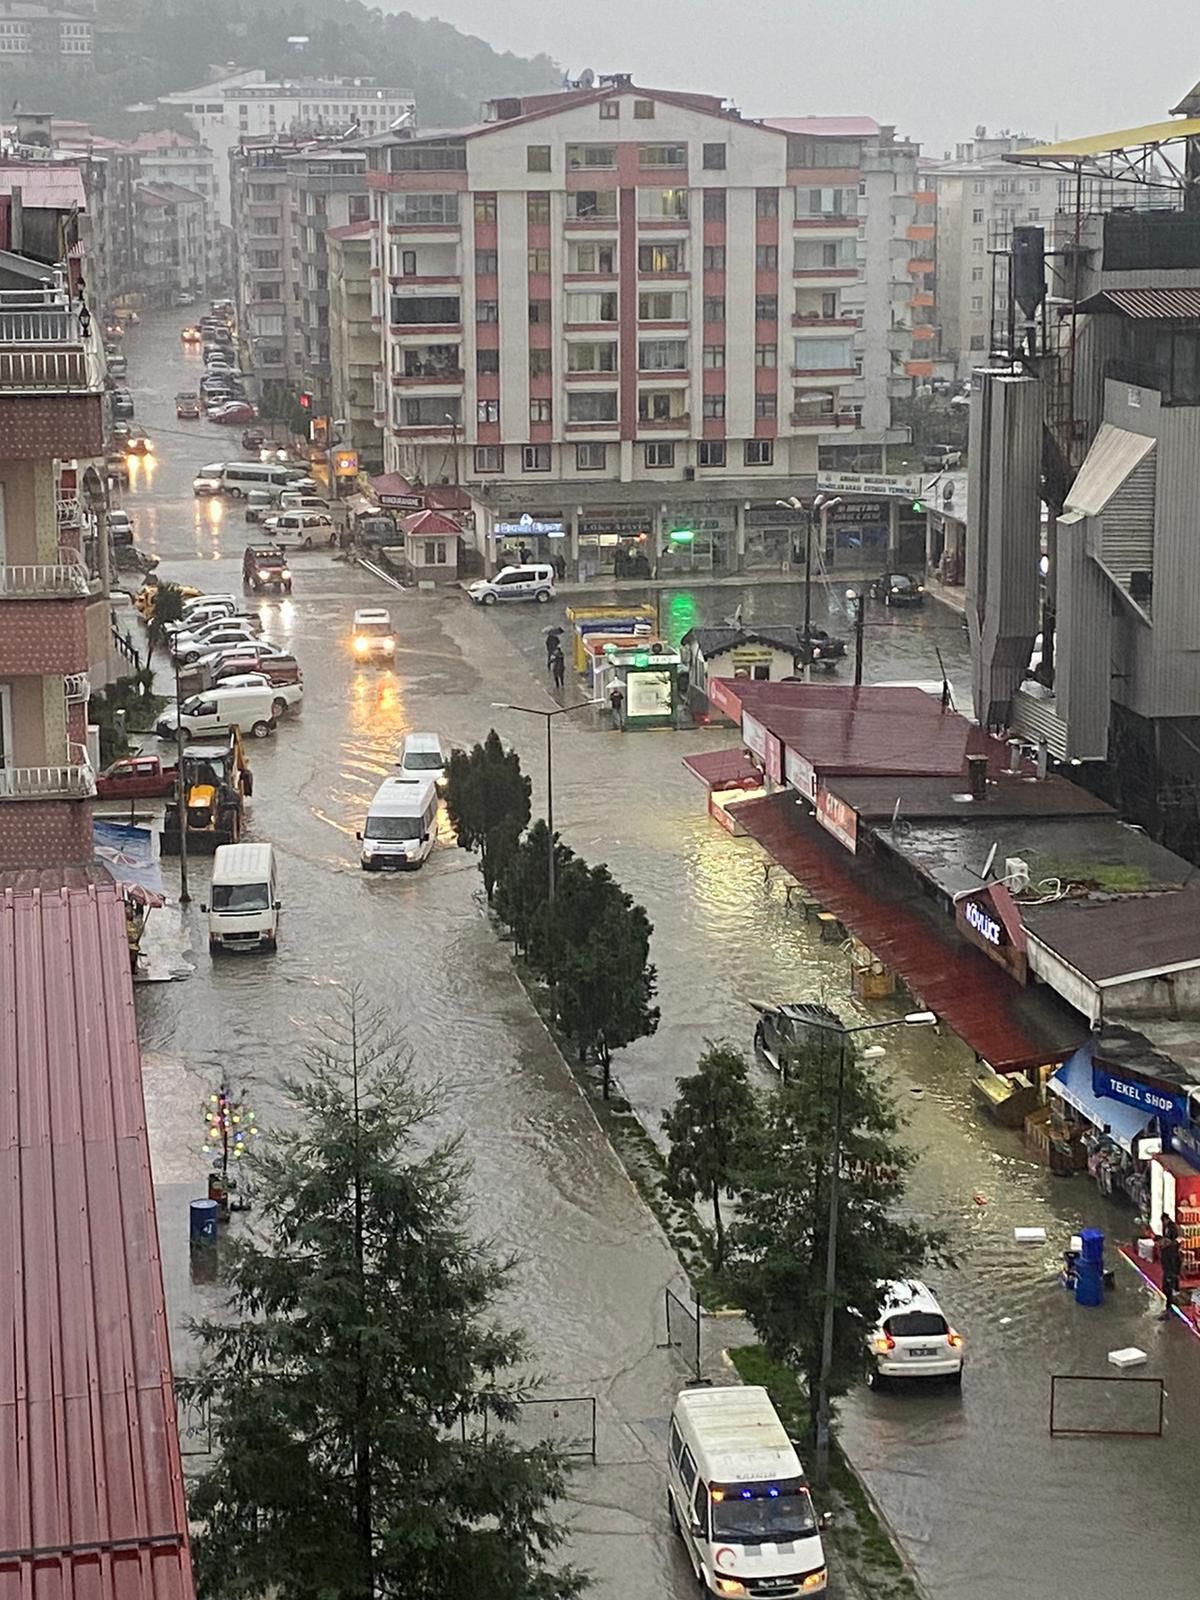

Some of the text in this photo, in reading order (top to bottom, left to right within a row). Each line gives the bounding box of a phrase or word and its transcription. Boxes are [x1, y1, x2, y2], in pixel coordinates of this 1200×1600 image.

[966, 902, 1001, 945] KÖYLÜCE
[1109, 1078, 1174, 1112] TEKEL SHOP
